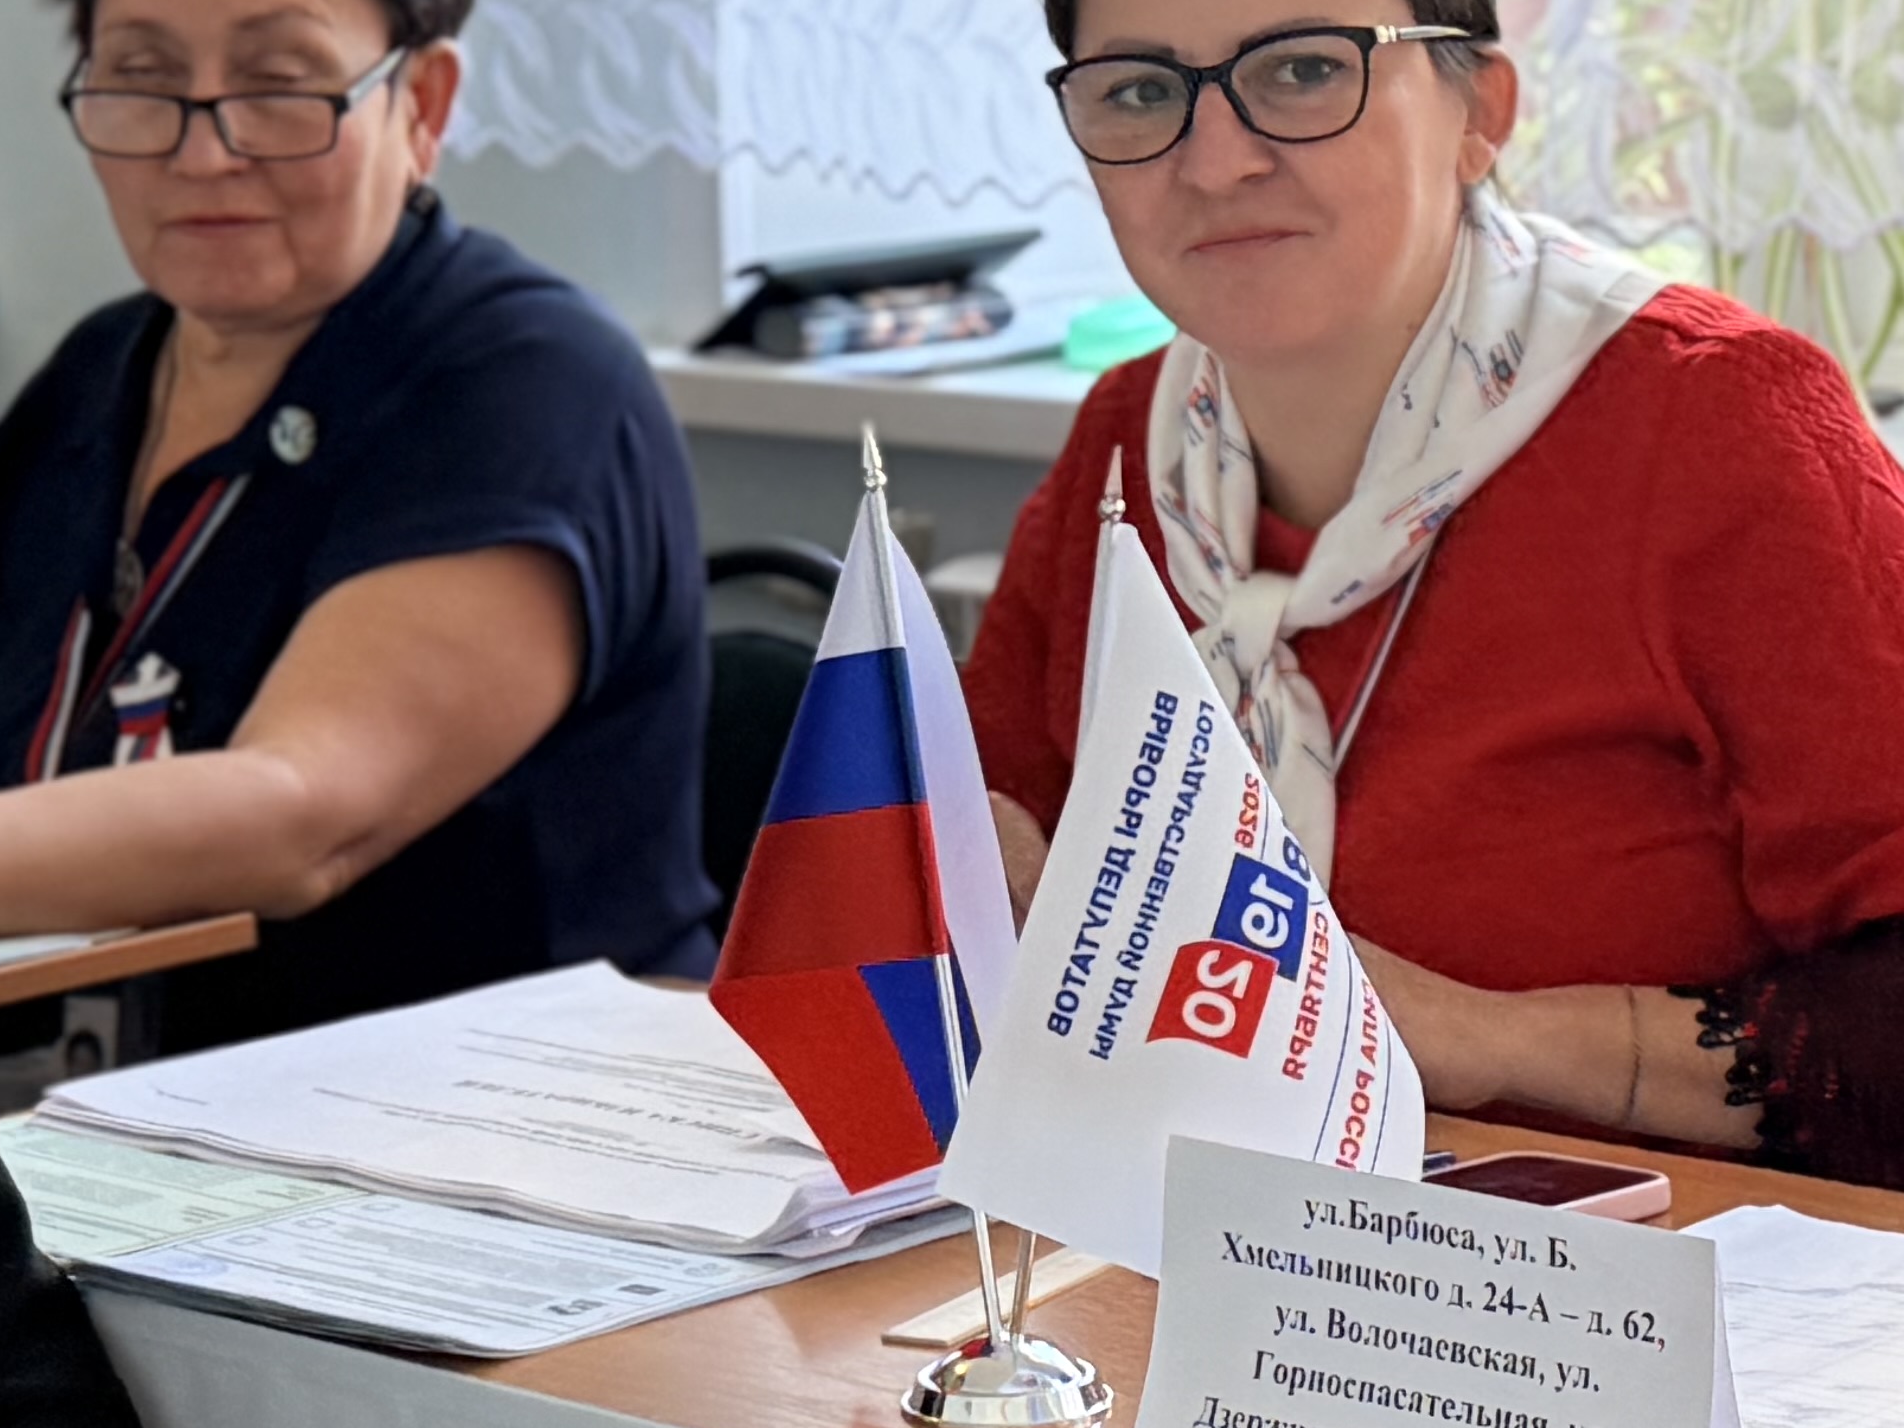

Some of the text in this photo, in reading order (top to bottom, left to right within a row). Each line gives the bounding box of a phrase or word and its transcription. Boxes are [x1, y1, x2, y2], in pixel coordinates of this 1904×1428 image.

[1302, 1196, 1578, 1271] ул.Барбюса, ул. Б.
[1220, 1230, 1440, 1301] Хмельницкого
[1446, 1282, 1473, 1310] д.
[1481, 1280, 1552, 1325] 24-А
[1586, 1310, 1613, 1337] д.
[1622, 1308, 1667, 1353] 62,
[1273, 1304, 1600, 1394] ул. Волочаевская, ул.
